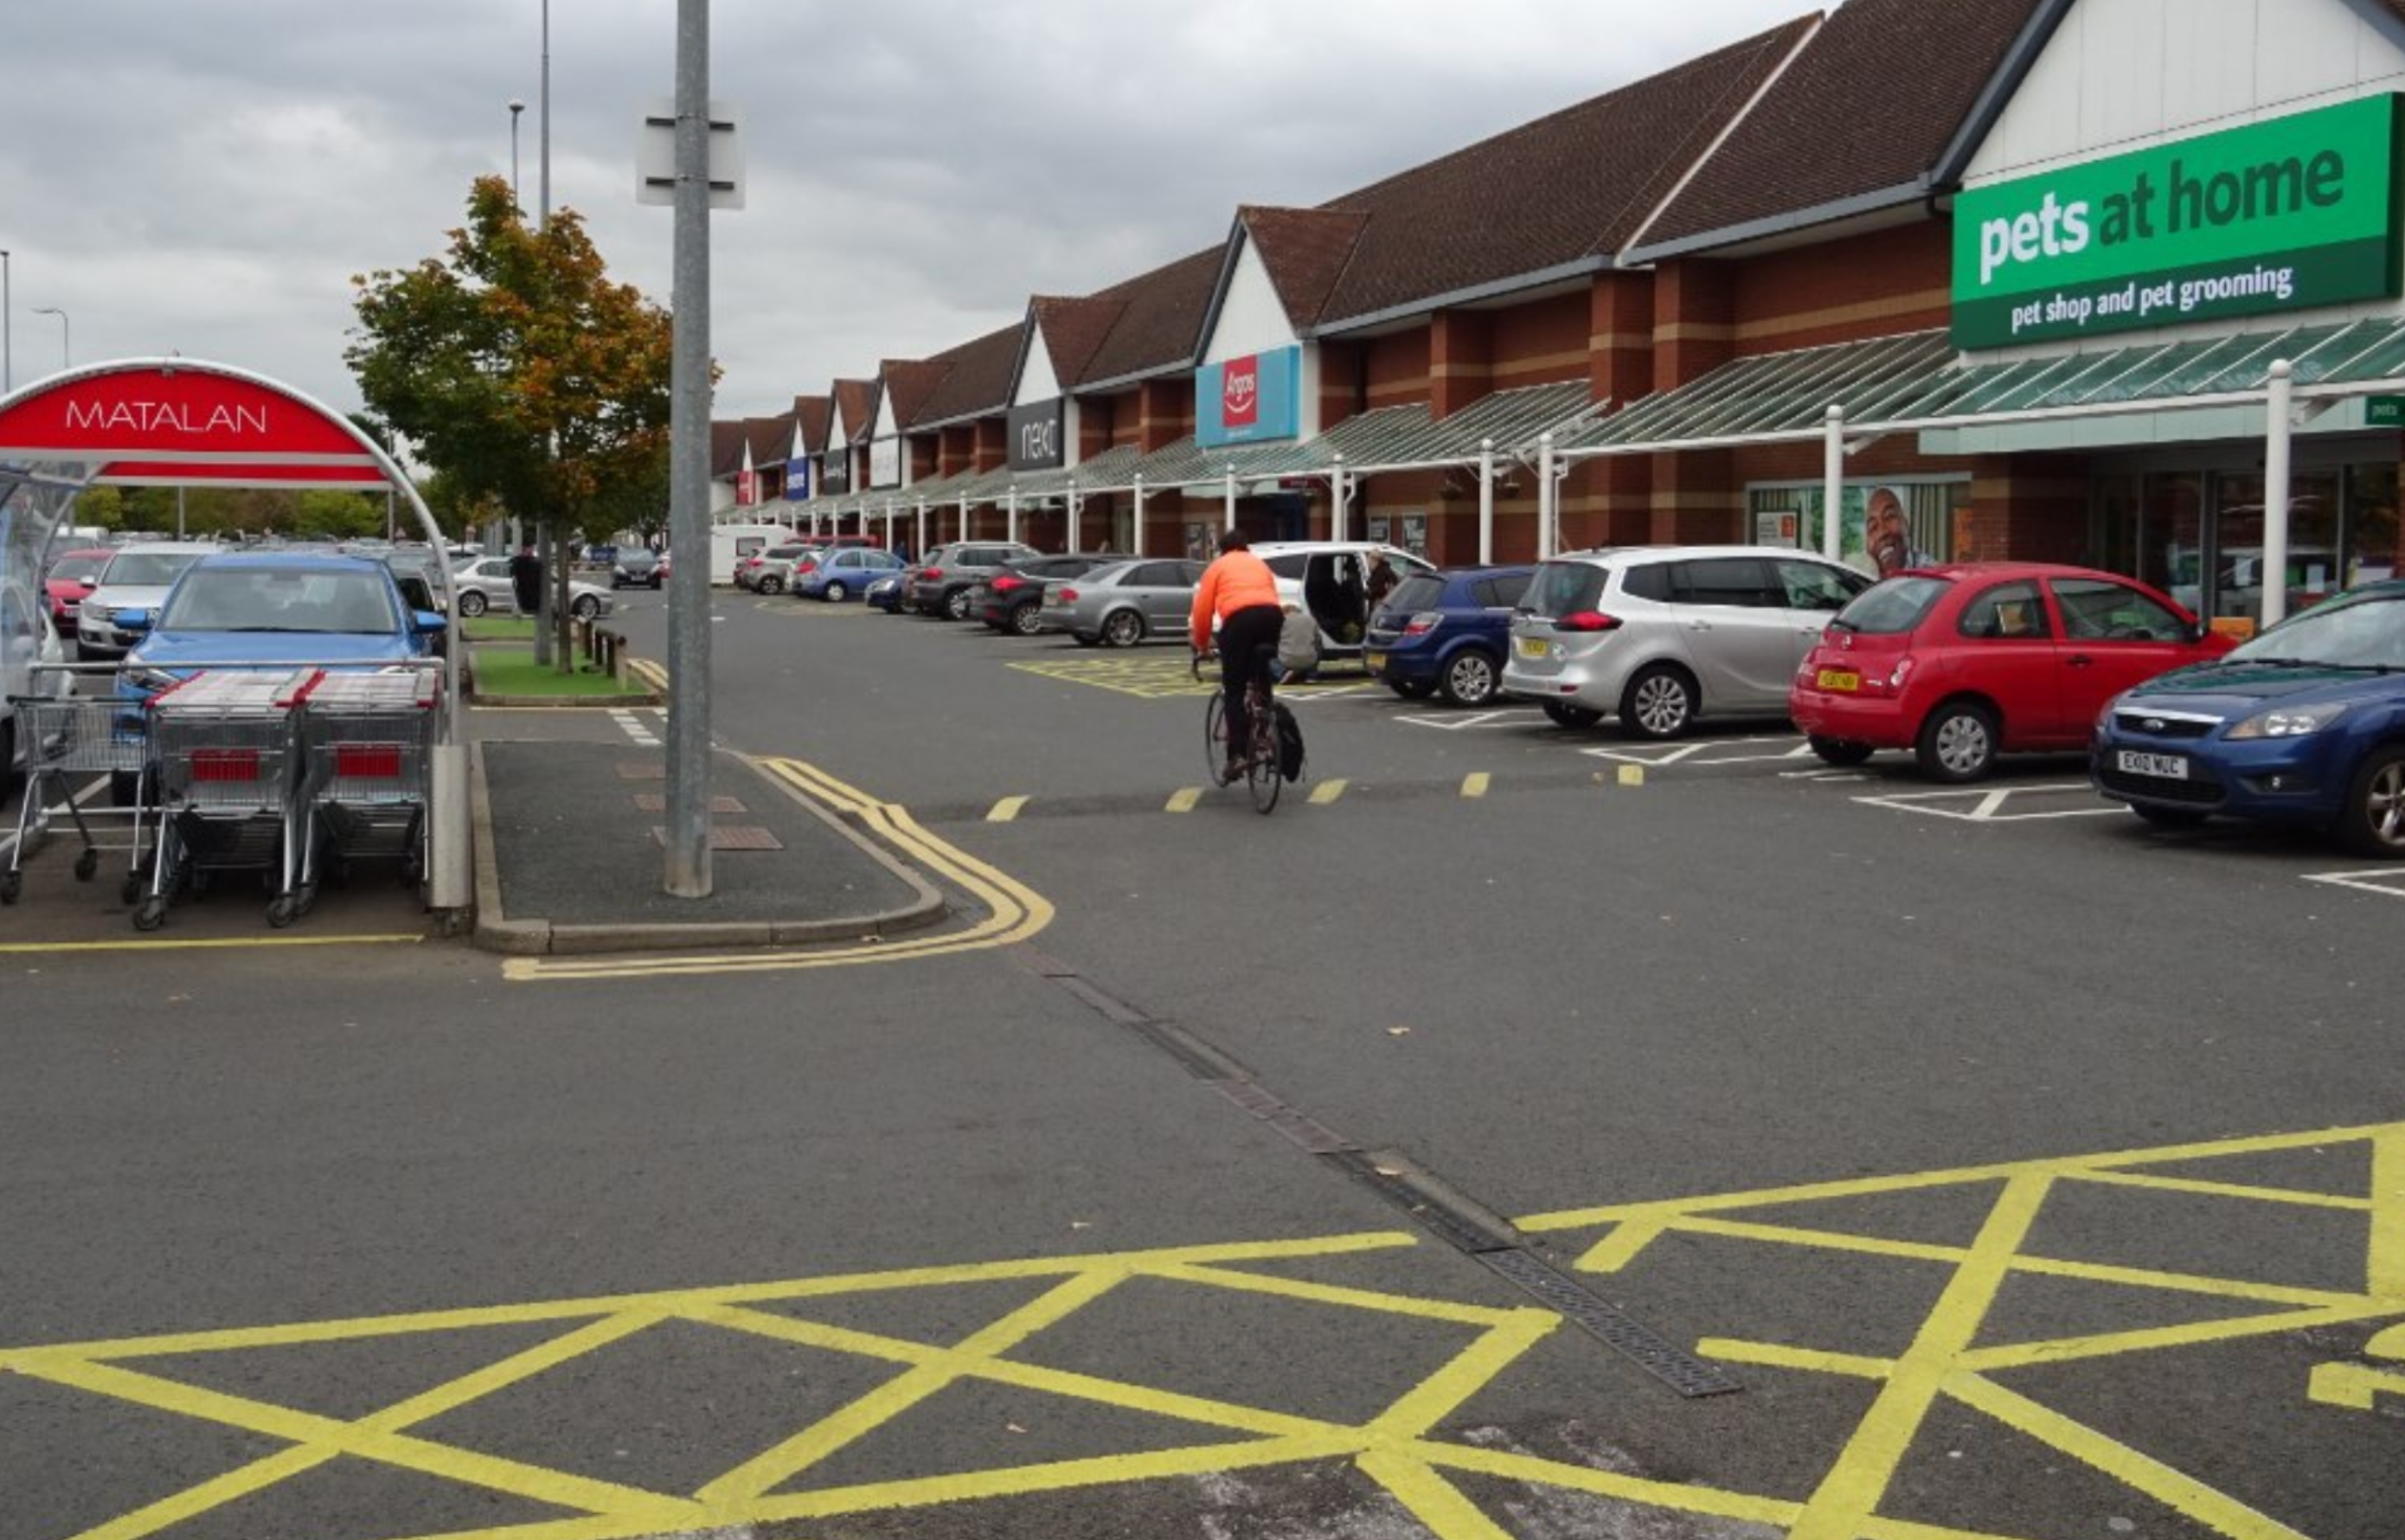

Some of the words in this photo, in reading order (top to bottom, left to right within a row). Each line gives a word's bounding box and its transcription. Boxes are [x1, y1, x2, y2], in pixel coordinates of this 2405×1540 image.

[1979, 191, 2090, 286] pets
[2100, 171, 2154, 246] at
[2167, 150, 2344, 234] home
[2011, 305, 2041, 334] pet
[2046, 293, 2092, 325] shop
[2097, 282, 2134, 314] and
[2139, 282, 2173, 316] pet
[2180, 266, 2293, 311] grooming
[1225, 372, 1255, 402] Argos
[66, 400, 266, 433] MATALAN
[1022, 419, 1057, 460] next
